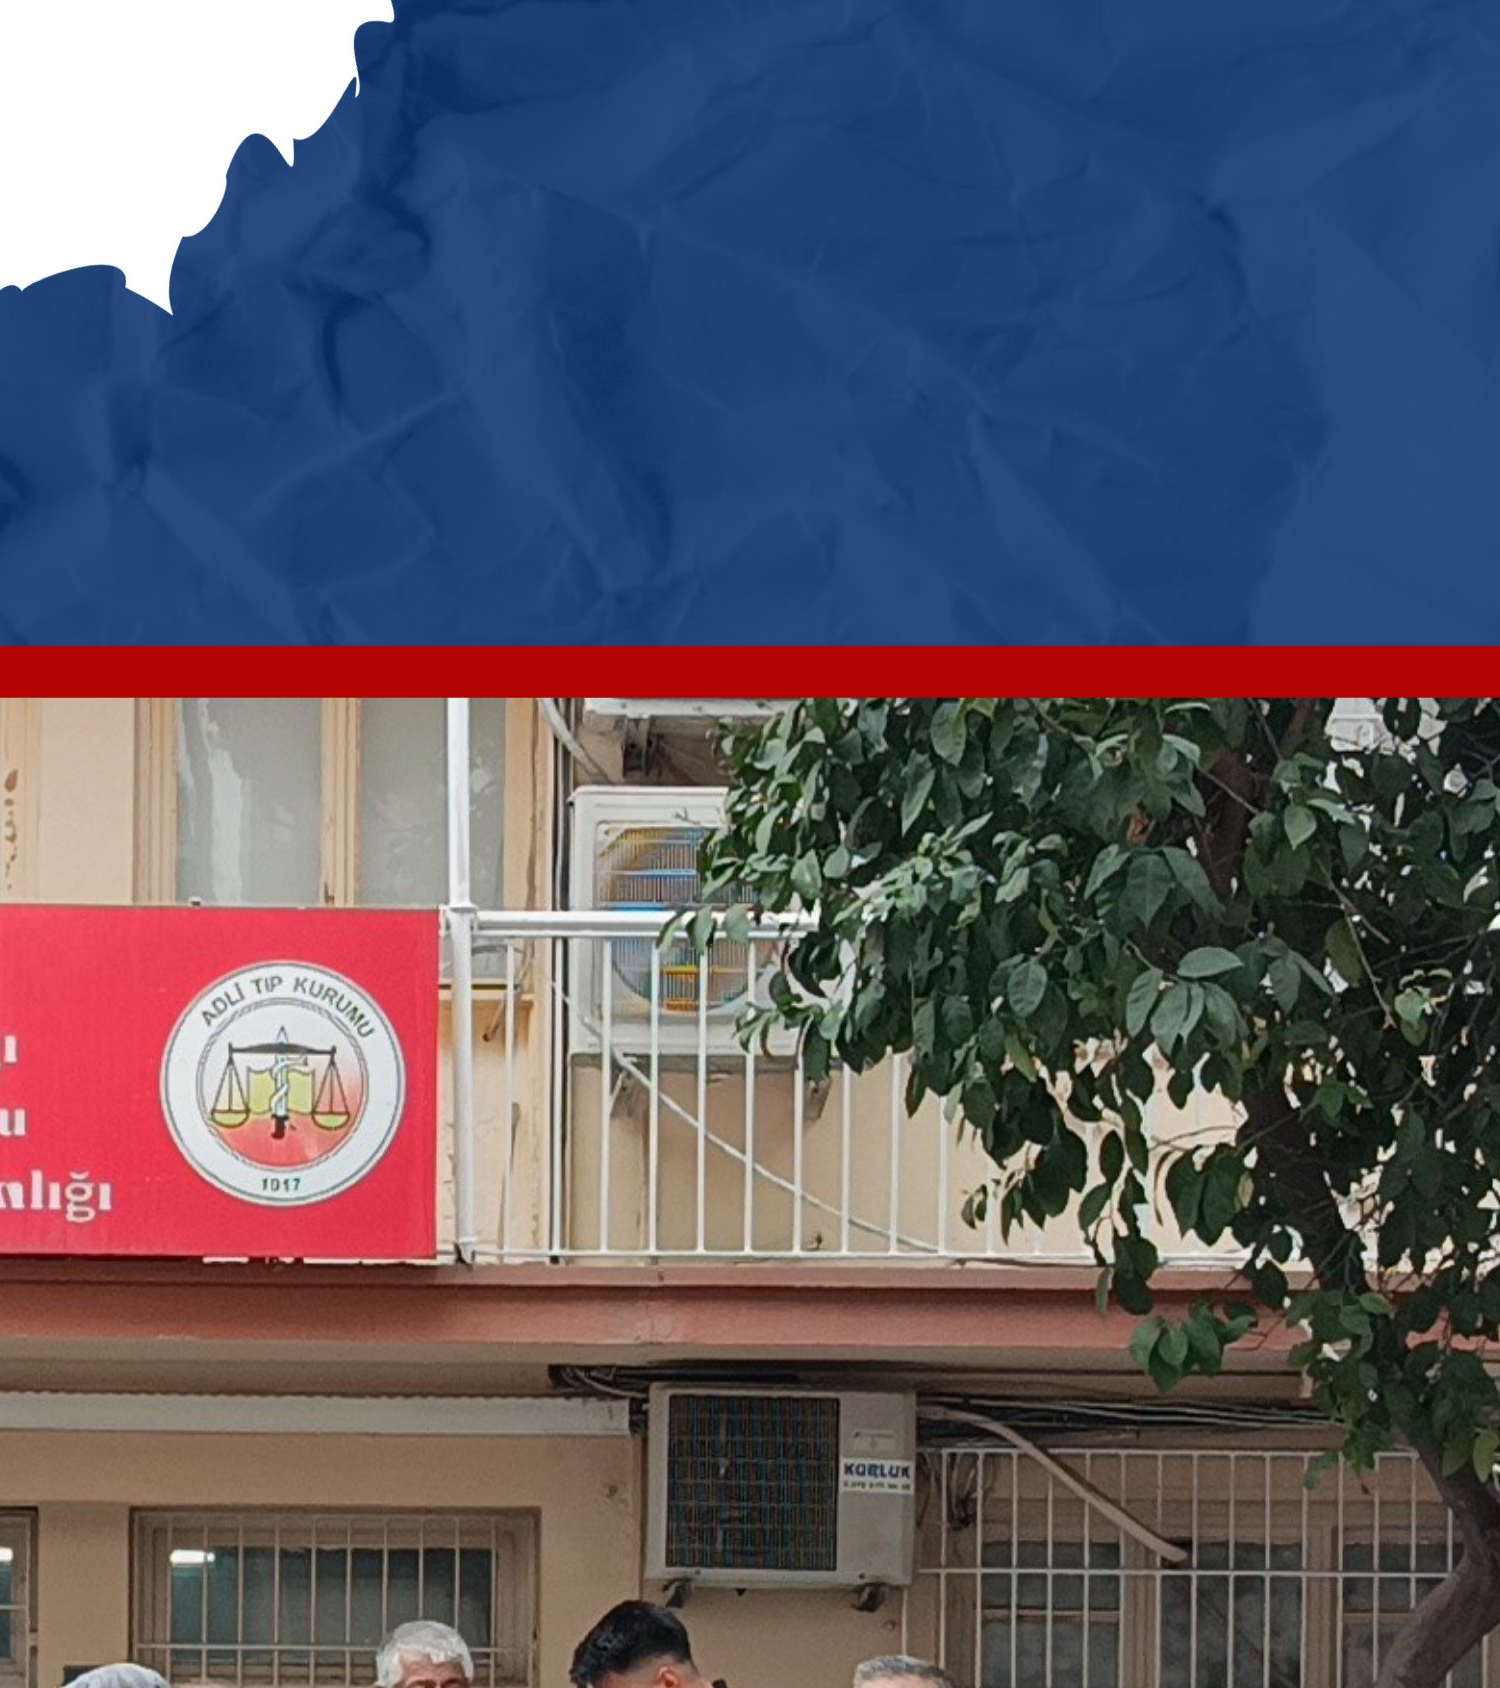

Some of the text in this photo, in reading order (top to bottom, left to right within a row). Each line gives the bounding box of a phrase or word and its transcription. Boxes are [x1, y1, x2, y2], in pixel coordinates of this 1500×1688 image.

[201, 975, 375, 1038] ADLİ TIP KURUMU
